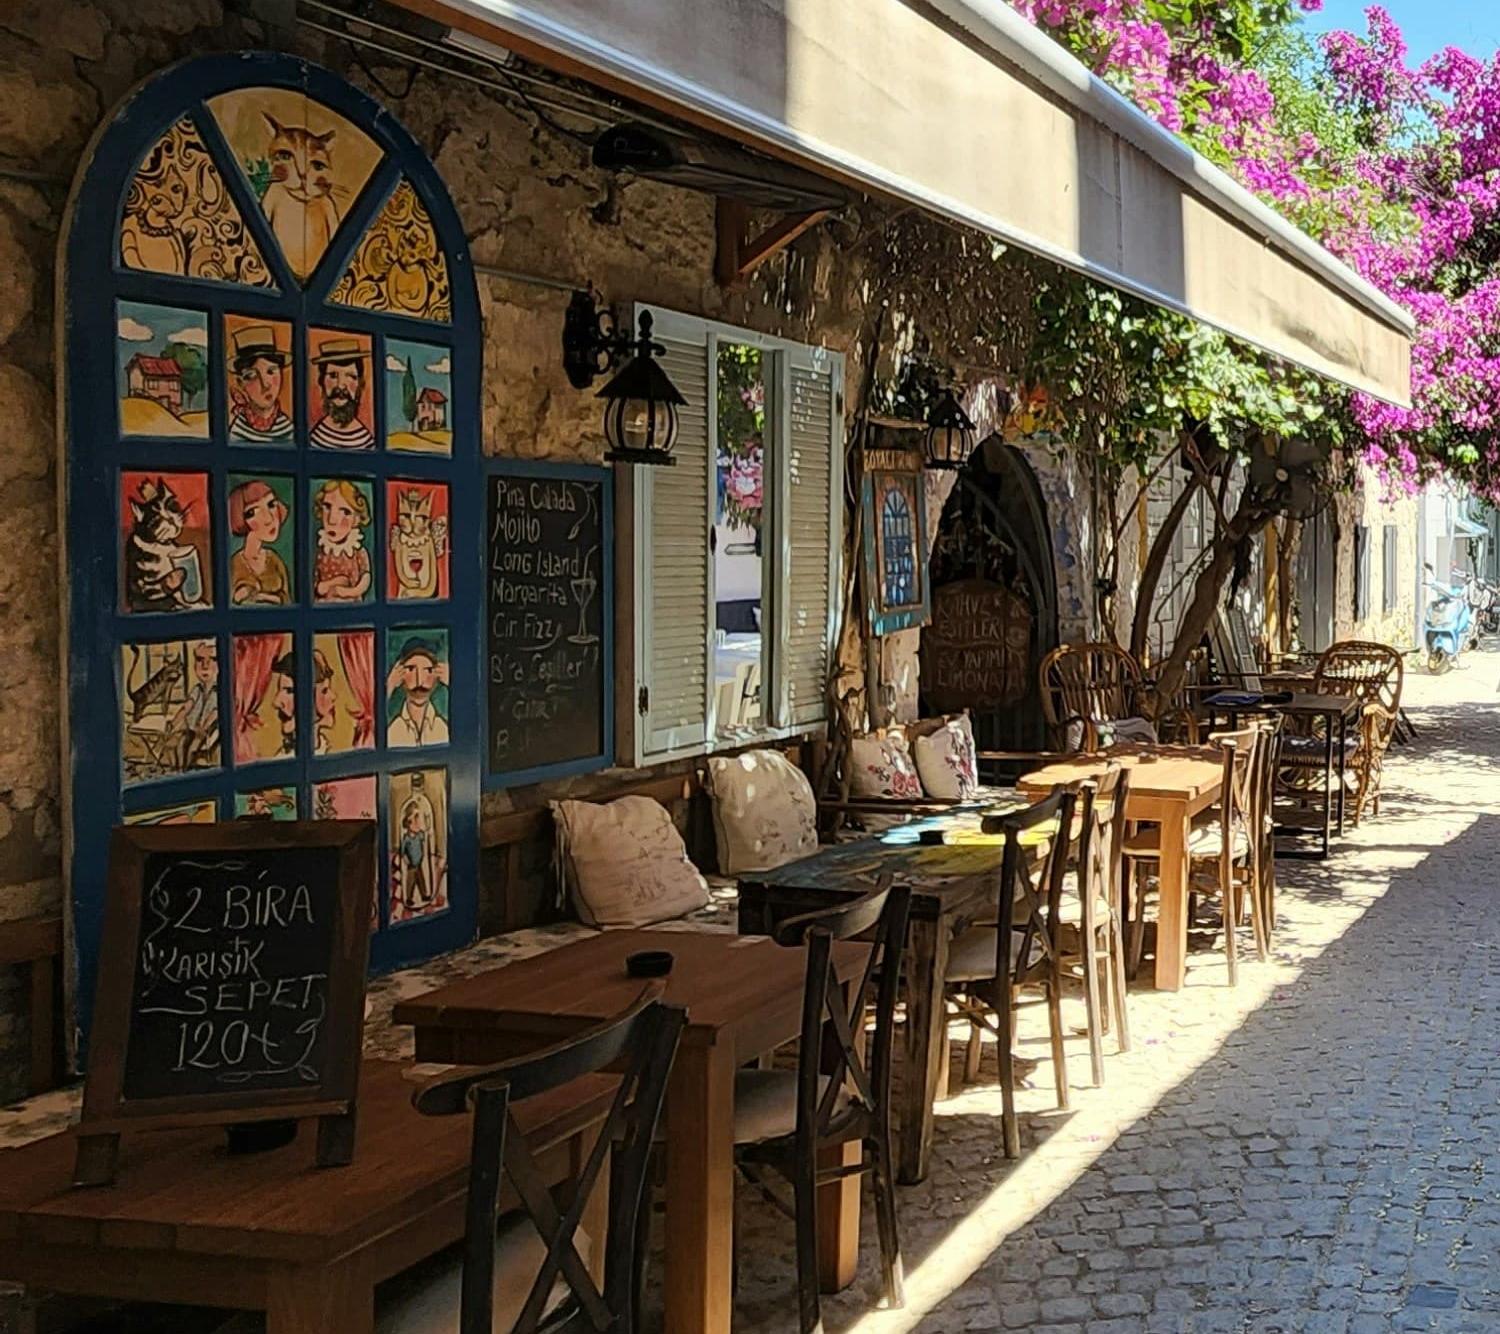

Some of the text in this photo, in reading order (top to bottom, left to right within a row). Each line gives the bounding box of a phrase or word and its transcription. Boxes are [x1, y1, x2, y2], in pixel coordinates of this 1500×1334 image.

[490, 510, 541, 546] Mojito
[491, 577, 568, 610] Margarita
[523, 613, 554, 640] Fizz
[173, 887, 213, 934] 2
[184, 973, 328, 1015] SEPET
